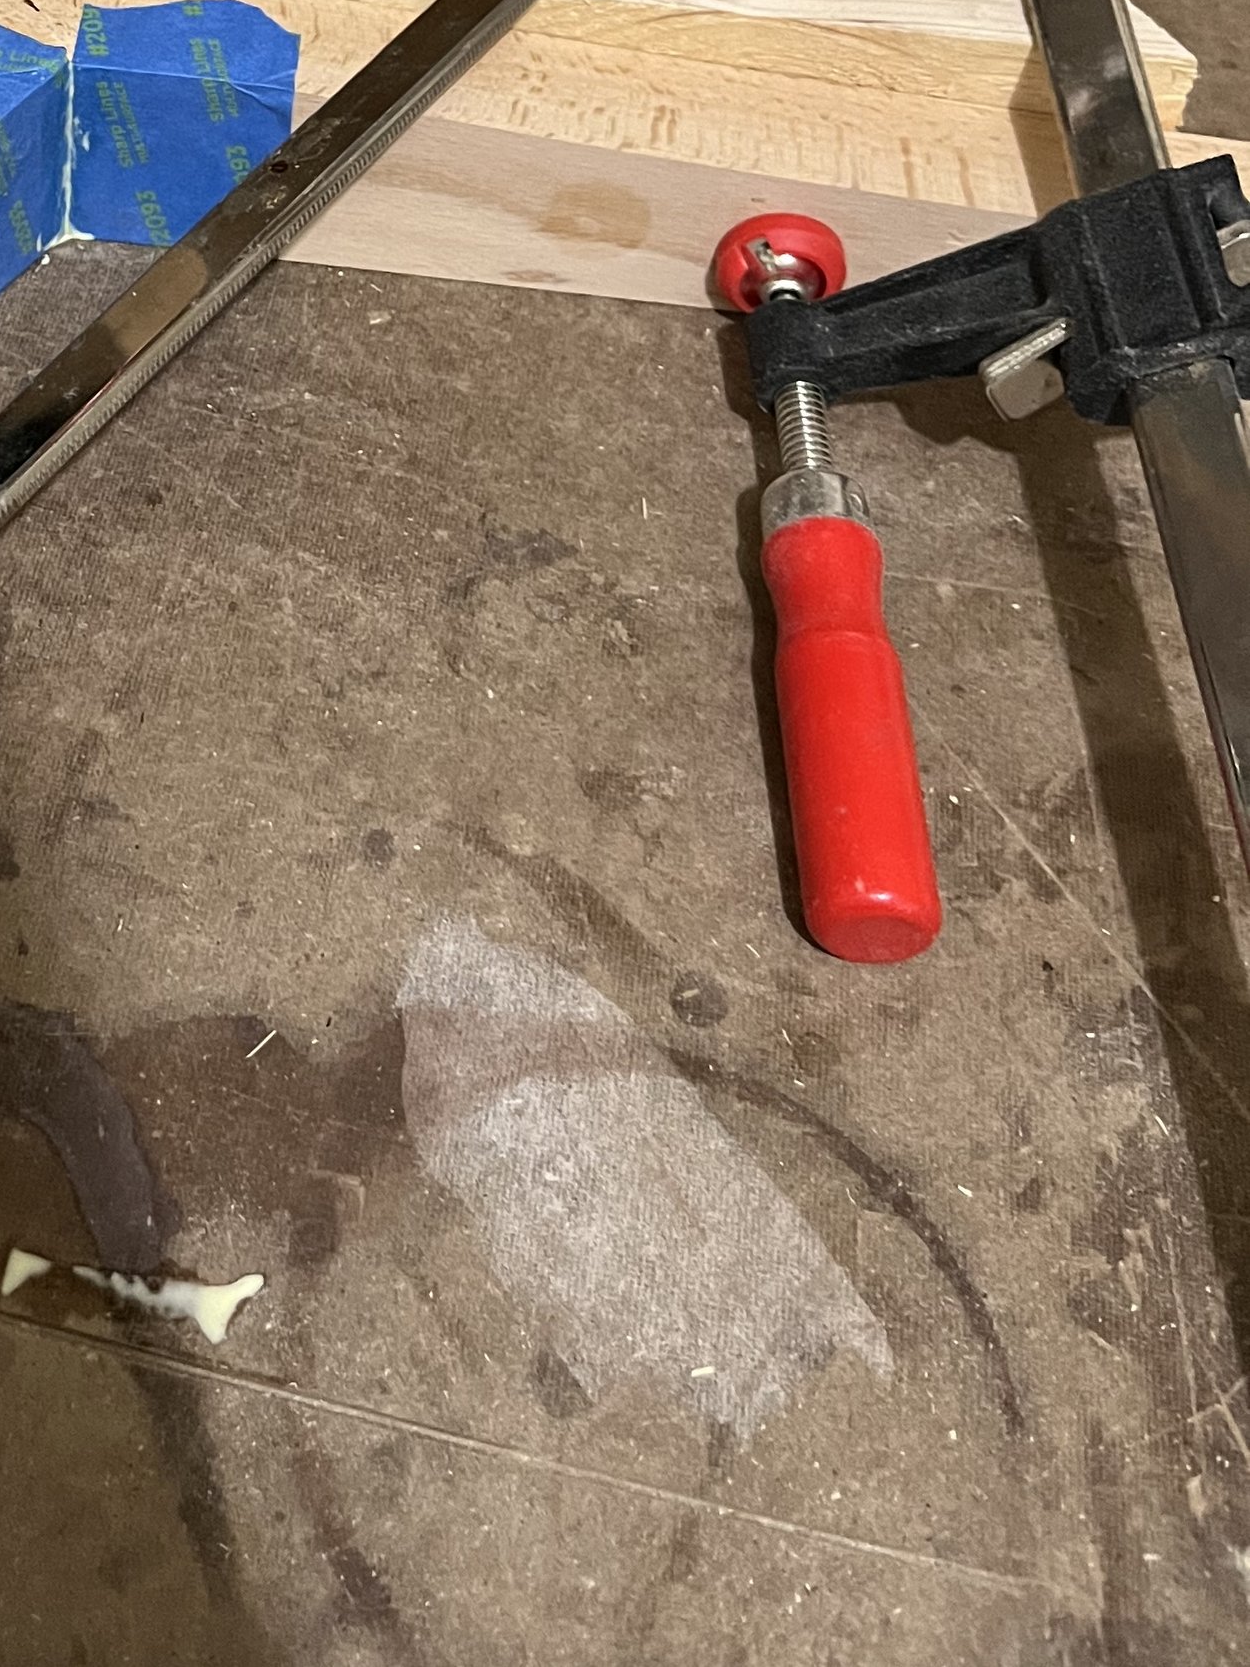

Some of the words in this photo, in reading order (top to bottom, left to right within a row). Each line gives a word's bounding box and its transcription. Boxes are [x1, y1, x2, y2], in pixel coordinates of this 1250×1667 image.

[189, 38, 211, 76] Lines
[96, 81, 118, 121] Lines
[202, 78, 225, 122] Sharp
[111, 124, 134, 169] Sharp
